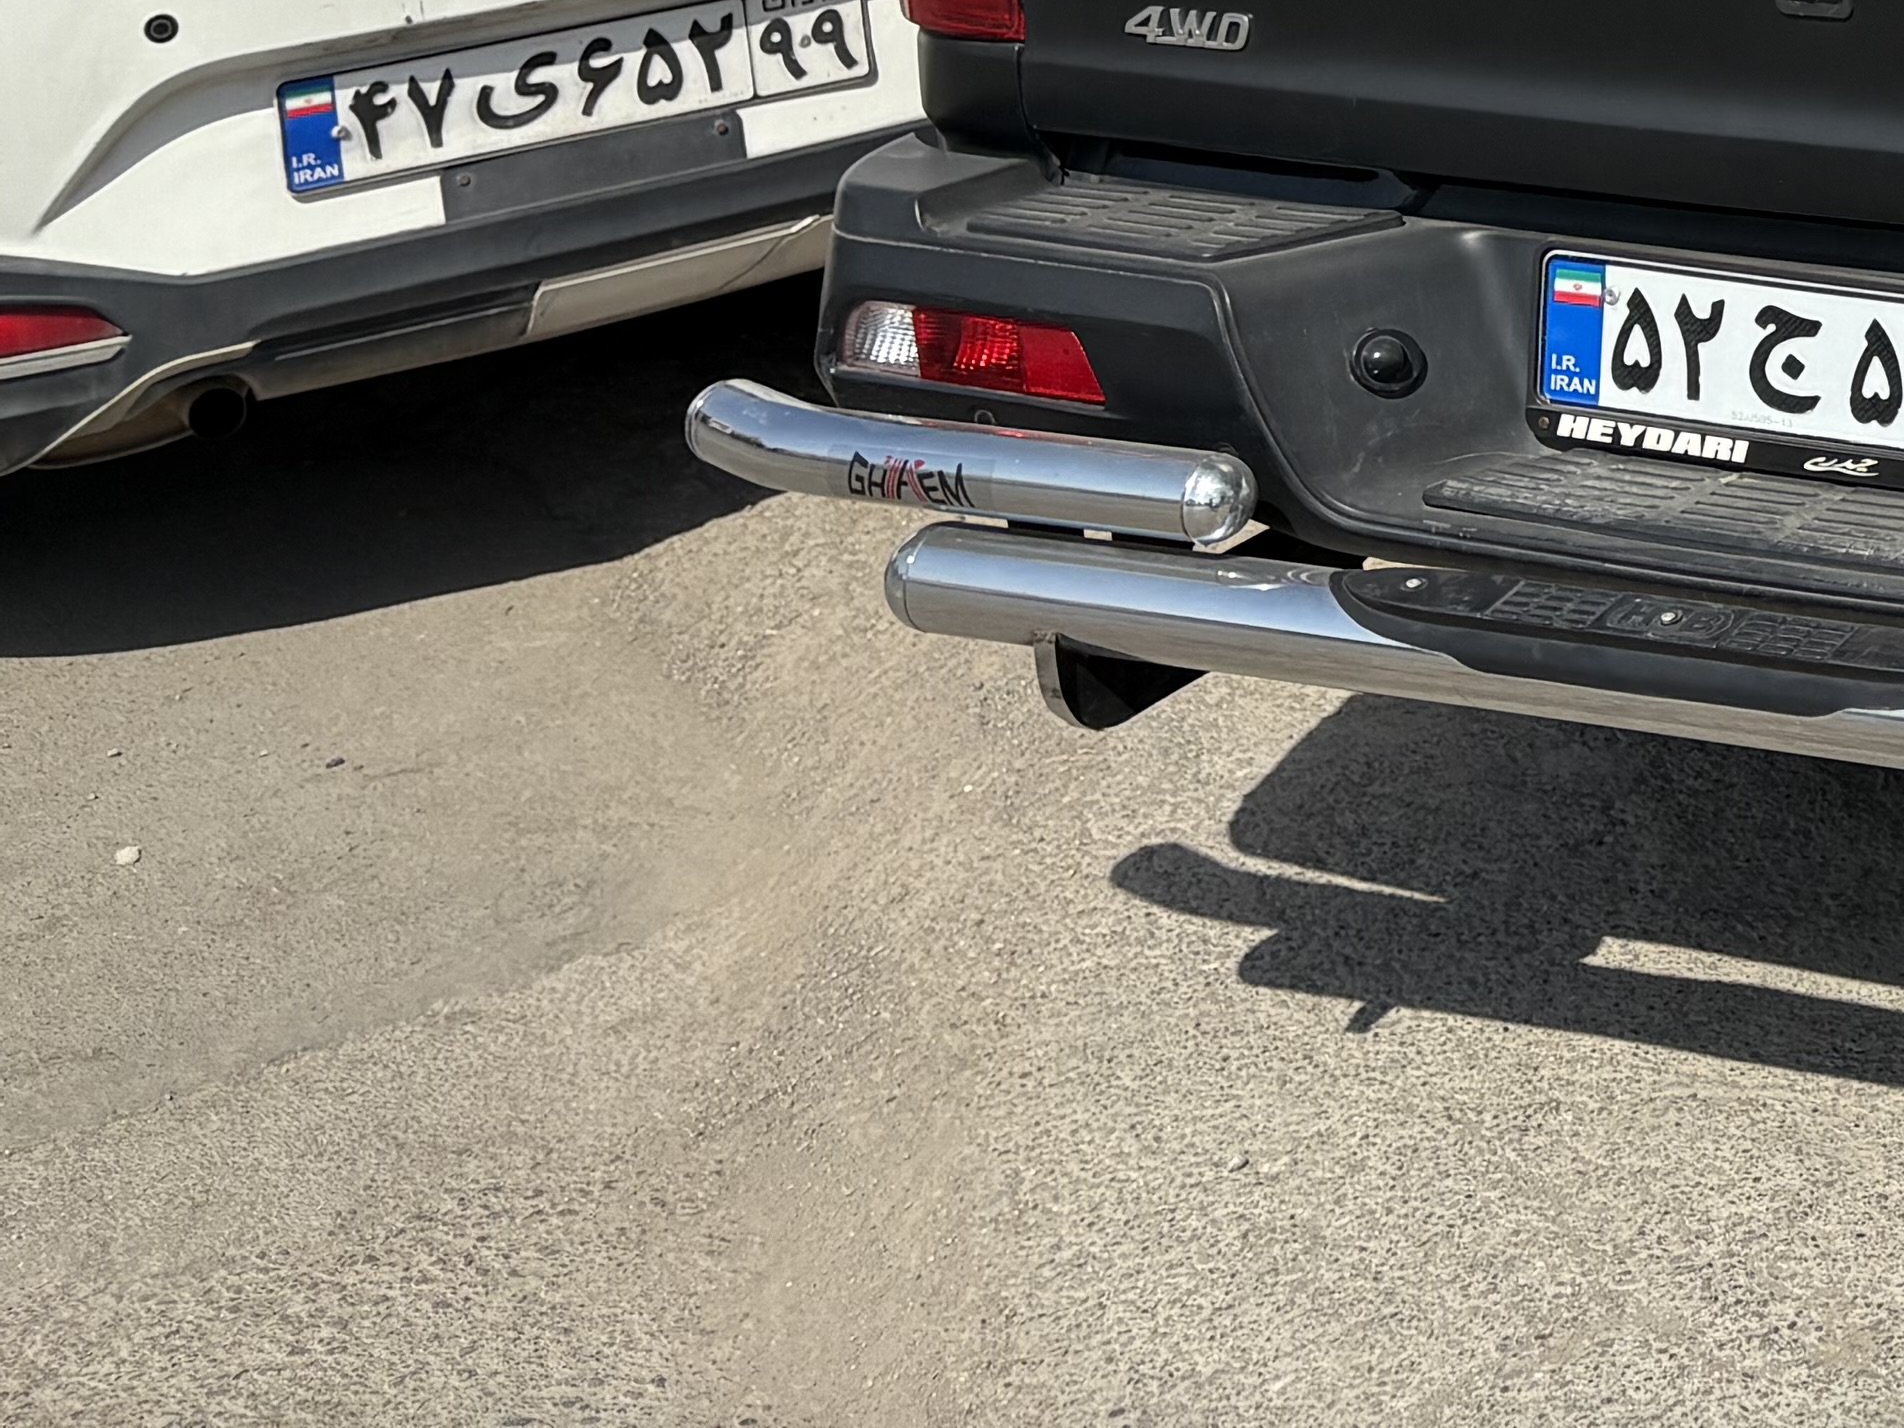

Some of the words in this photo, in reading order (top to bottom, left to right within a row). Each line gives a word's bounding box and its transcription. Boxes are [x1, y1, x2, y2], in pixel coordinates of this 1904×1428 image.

[1123, 3, 1254, 52] 4WD
[293, 164, 340, 186] IRAN
[1551, 353, 1580, 373] I.R.
[1550, 374, 1596, 395] IRAN
[1557, 414, 1749, 466] HEYDARI
